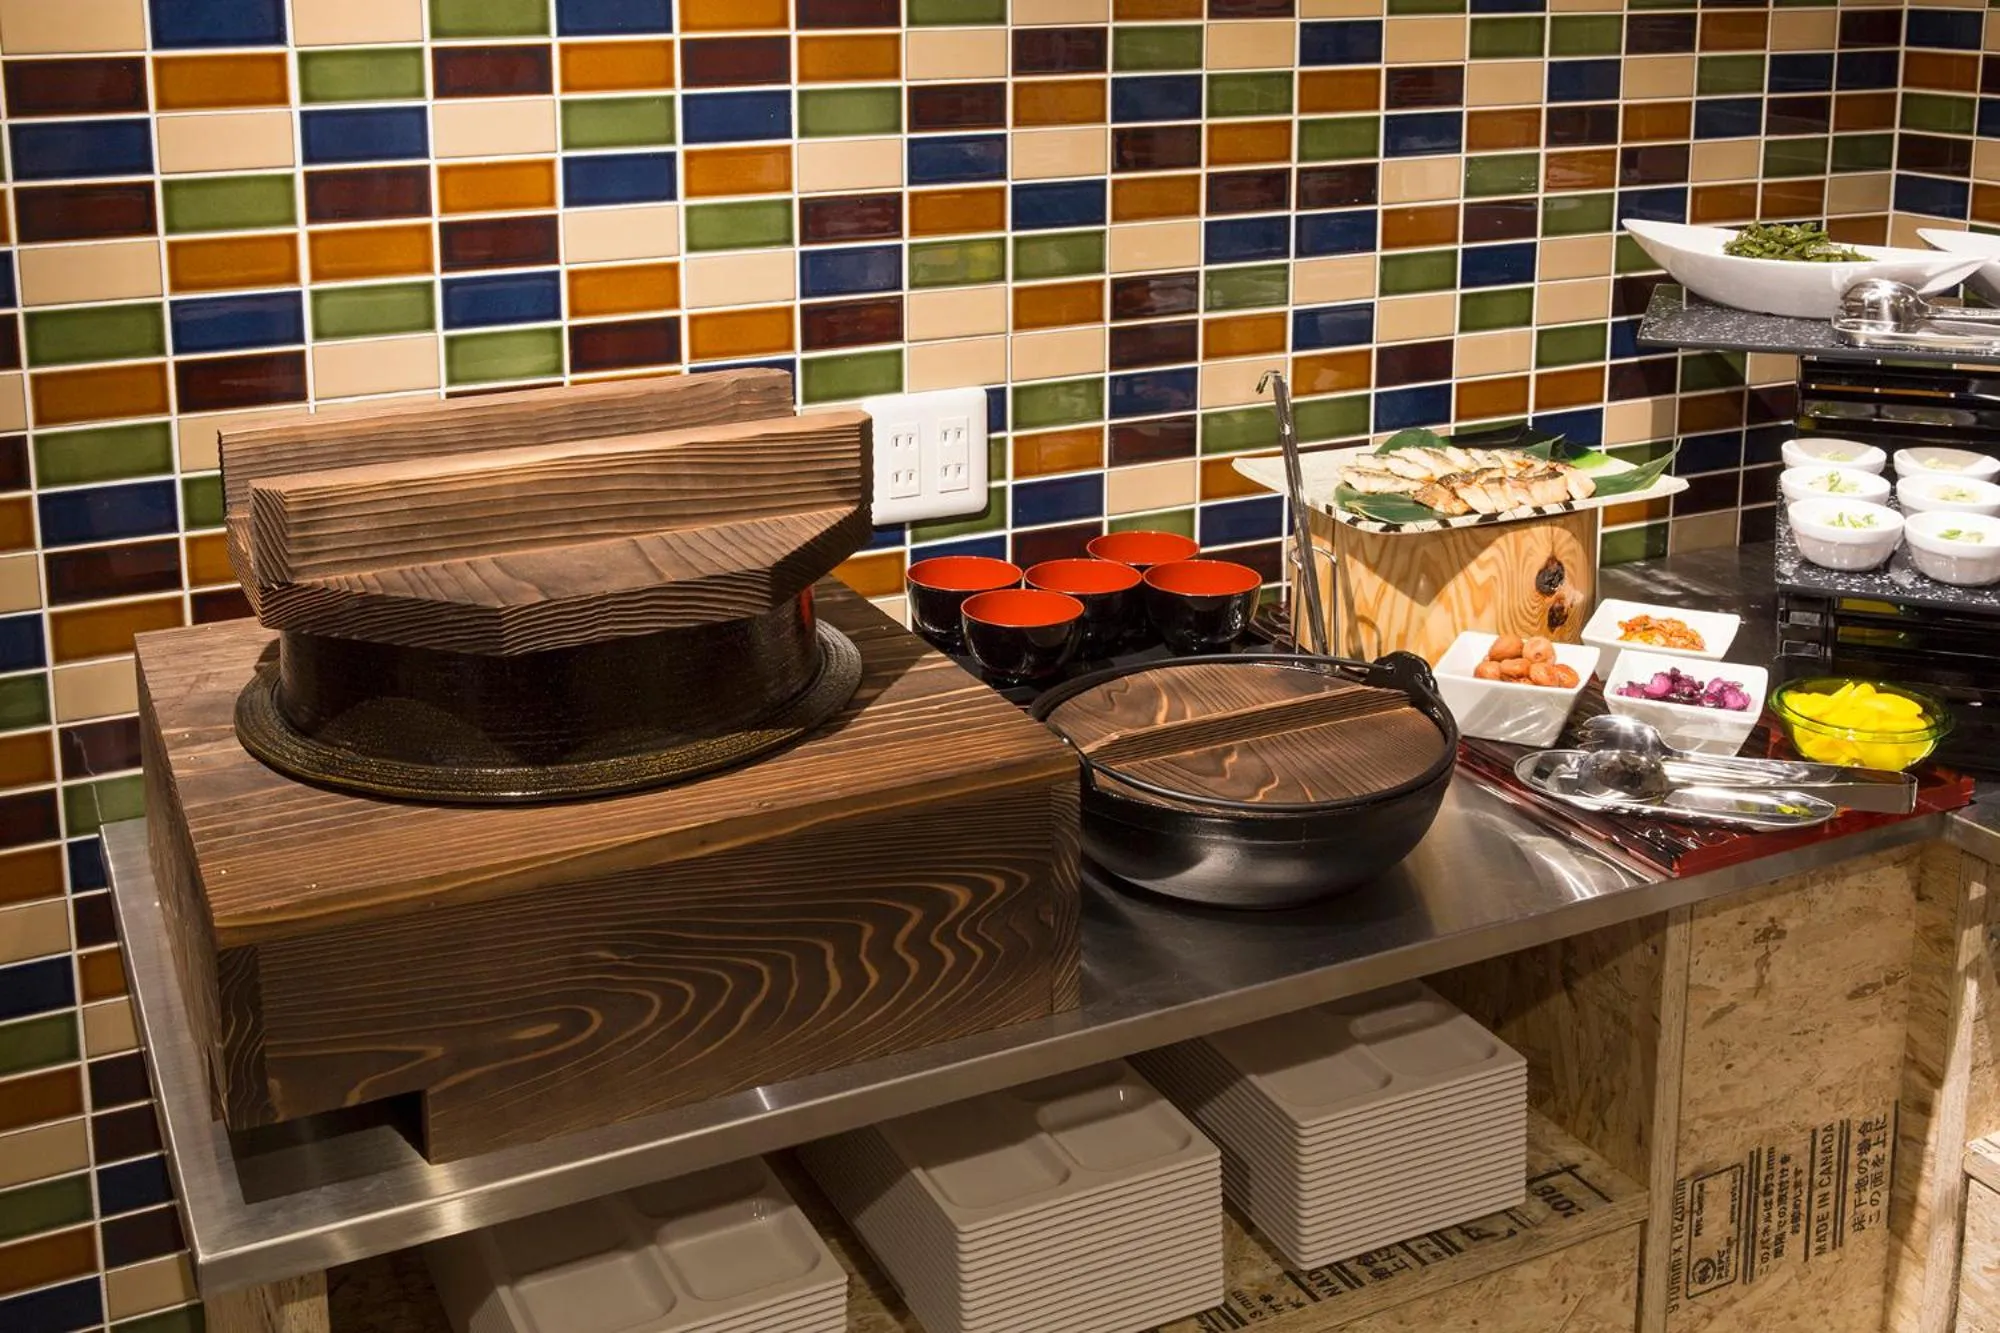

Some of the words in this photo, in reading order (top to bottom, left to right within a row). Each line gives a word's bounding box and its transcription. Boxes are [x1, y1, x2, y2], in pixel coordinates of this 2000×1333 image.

[1818, 1123, 1835, 1188] CANADA
[1852, 1121, 1874, 1233] 床下地の場合
[1868, 1114, 1888, 1224] この面を上に
[1817, 1191, 1830, 1209] IN
[1814, 1211, 1830, 1257] MADE
